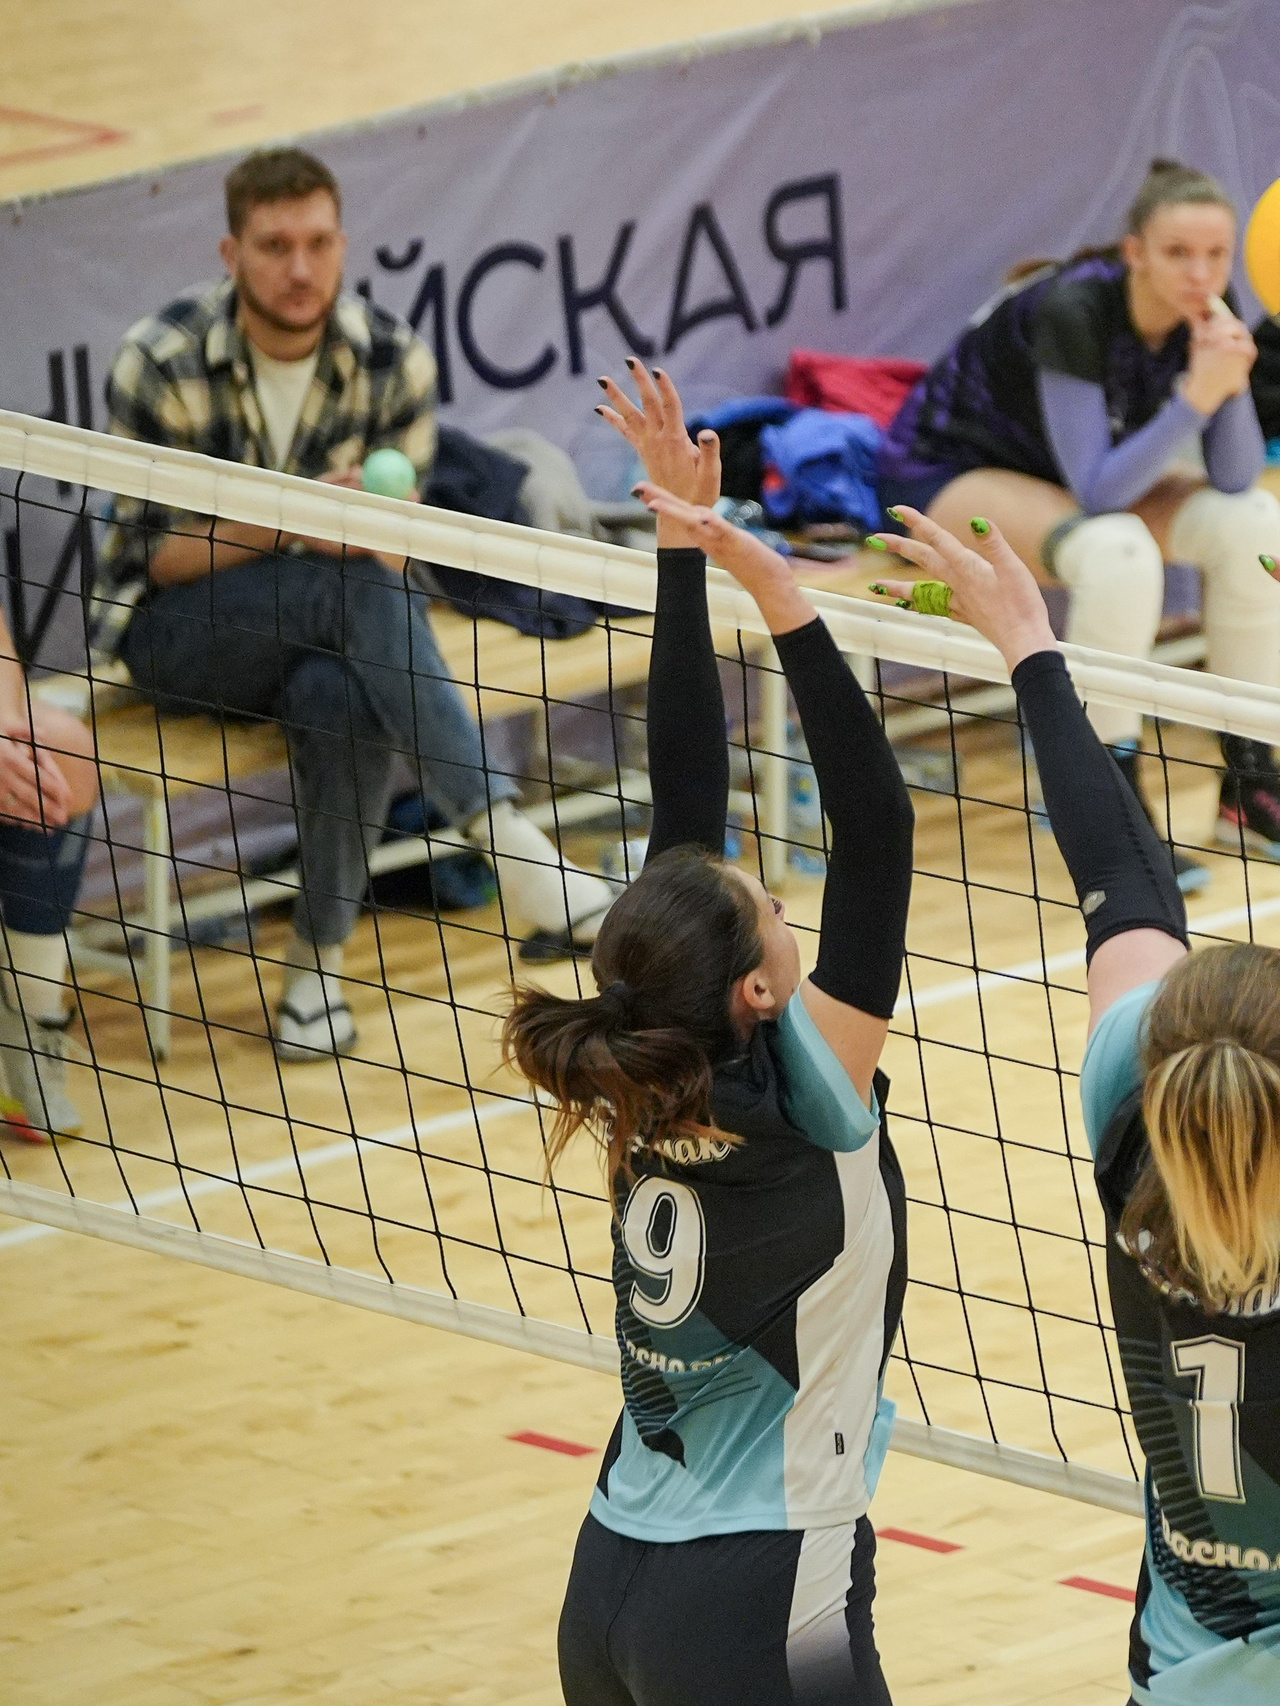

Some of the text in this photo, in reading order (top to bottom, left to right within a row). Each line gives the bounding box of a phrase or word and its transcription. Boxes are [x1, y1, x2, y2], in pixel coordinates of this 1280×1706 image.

[355, 172, 848, 404] ЙСКАЯ
[621, 1174, 706, 1329] 9
[1170, 1333, 1246, 1504] 1
